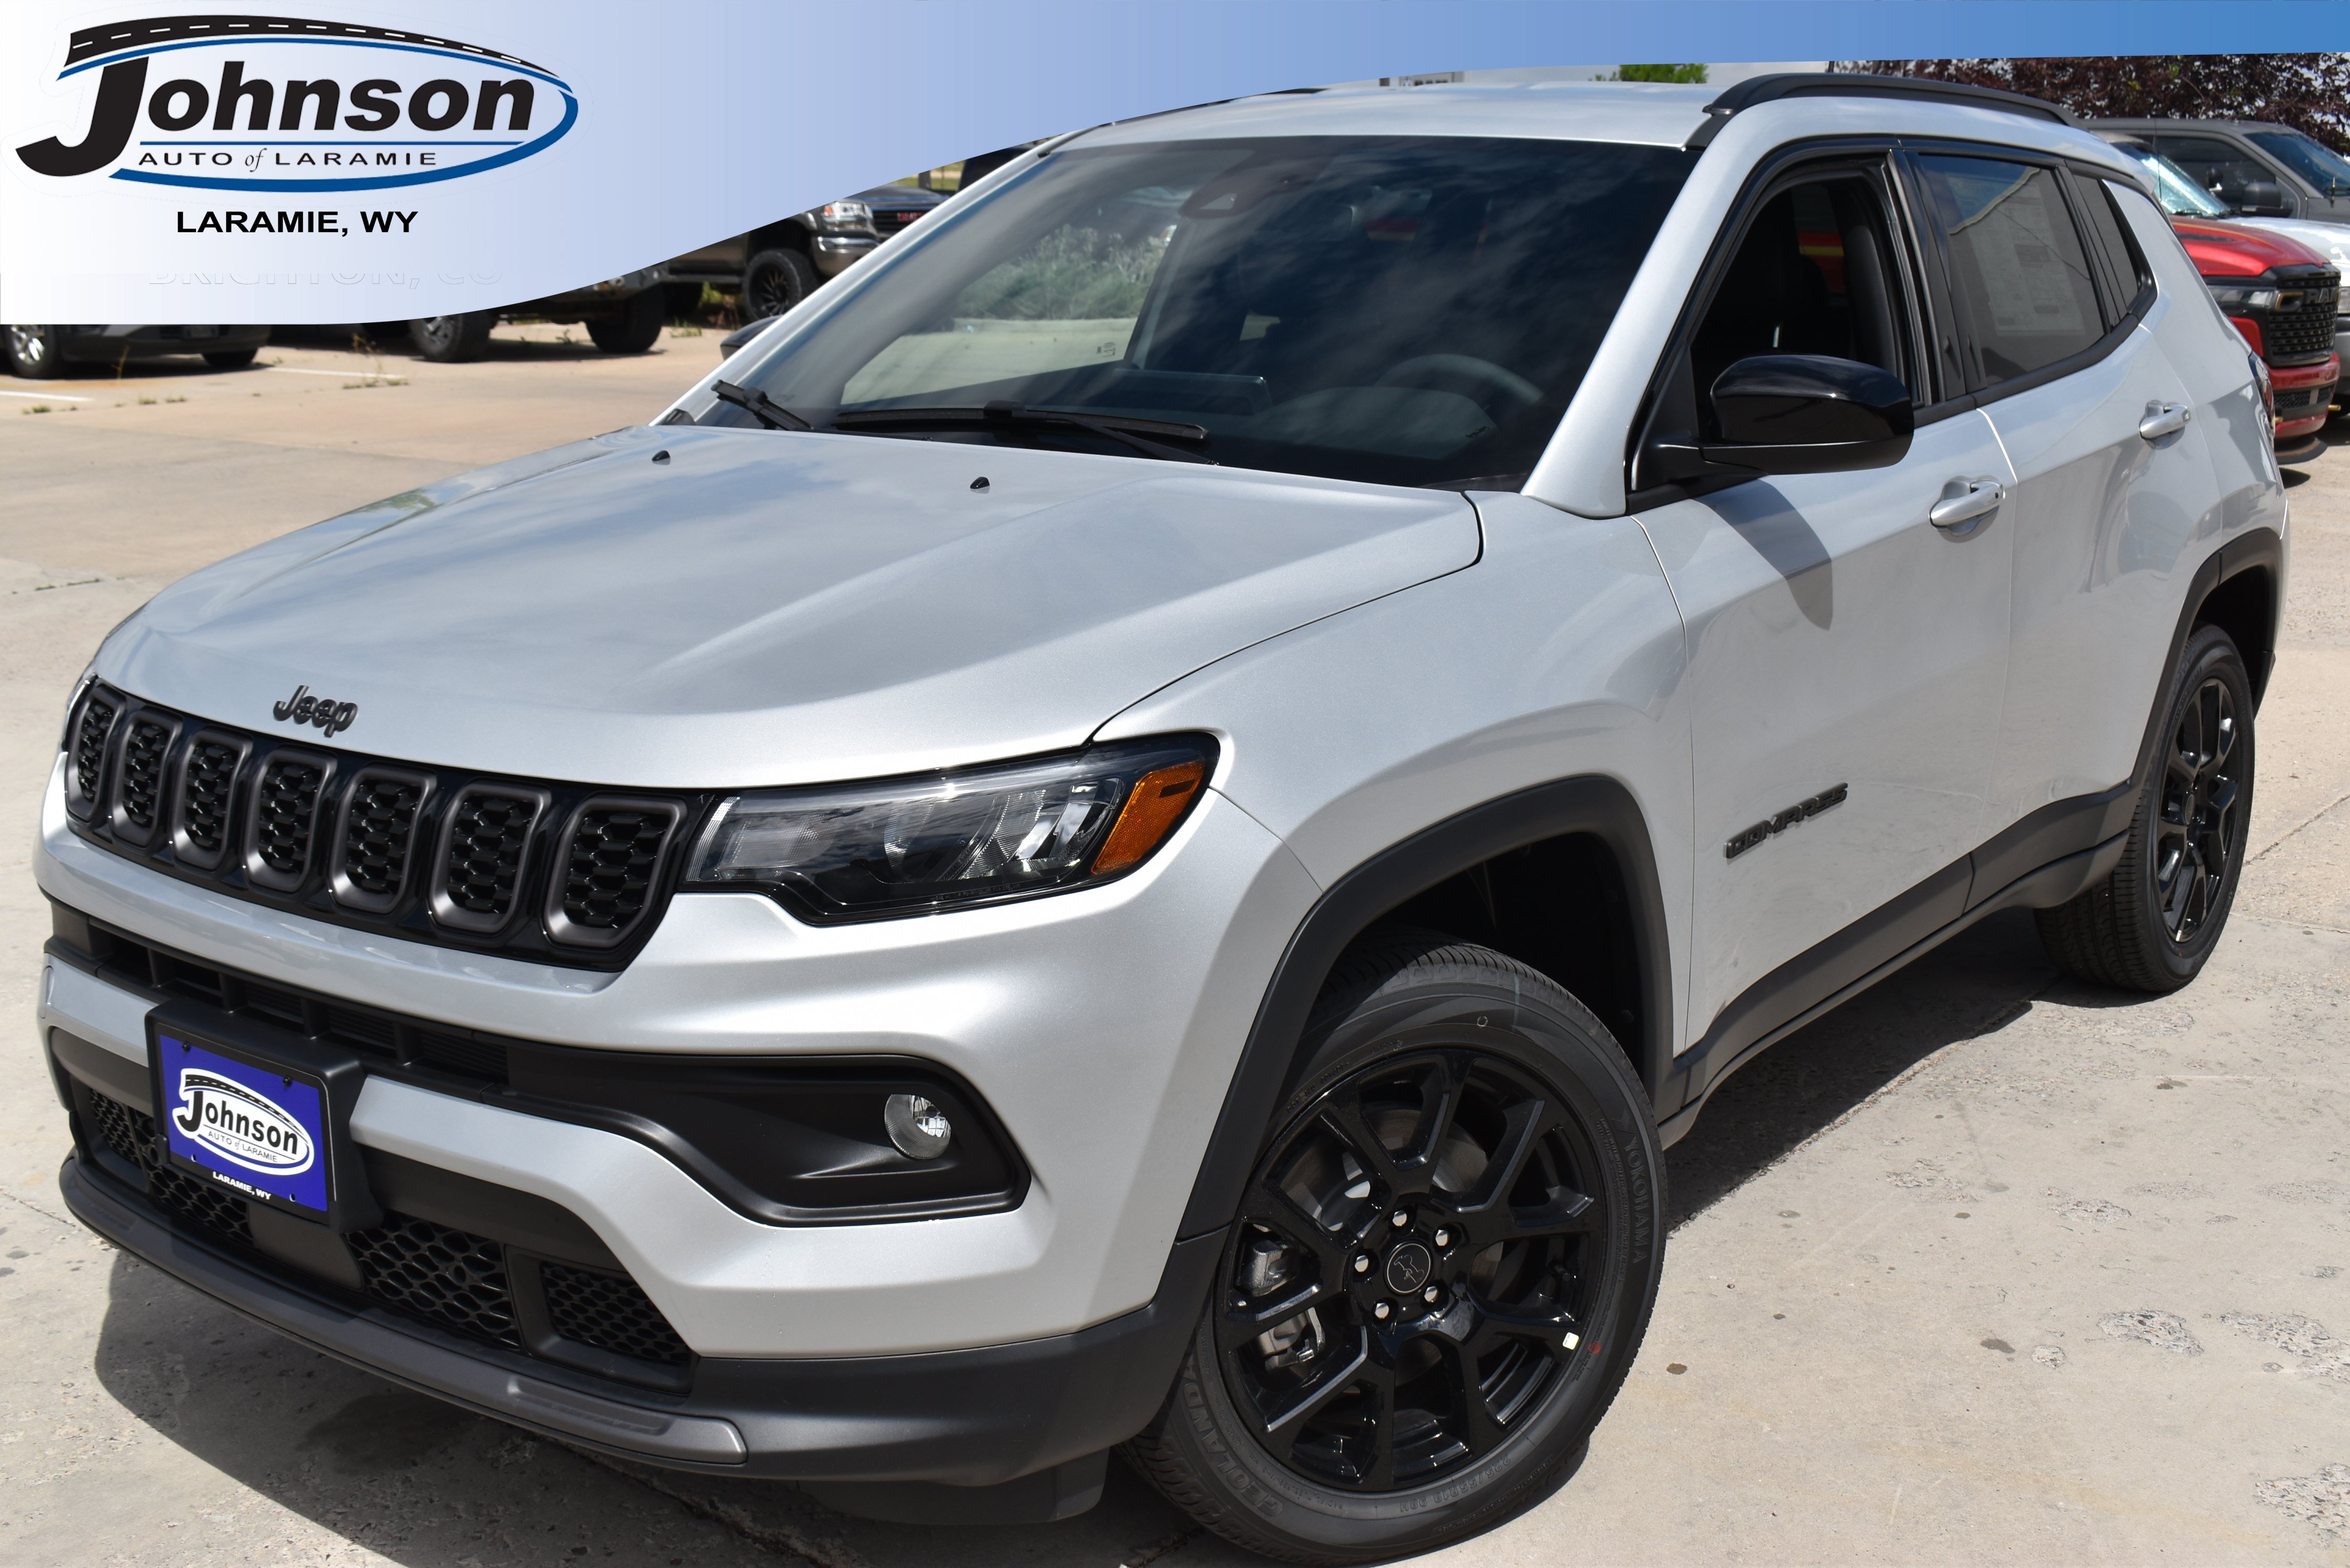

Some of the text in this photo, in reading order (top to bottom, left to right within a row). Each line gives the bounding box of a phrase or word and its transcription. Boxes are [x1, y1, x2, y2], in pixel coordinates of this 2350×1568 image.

[273, 685, 358, 738] Jeep
[1725, 782, 1848, 859] COMPASS
[177, 1090, 298, 1155] Johnson
[208, 1131, 232, 1145] AUTO
[243, 1144, 278, 1163] LARAMIE
[213, 1171, 272, 1200] LARAMIE, WY
[1624, 1136, 1650, 1264] YOKOHAMA
